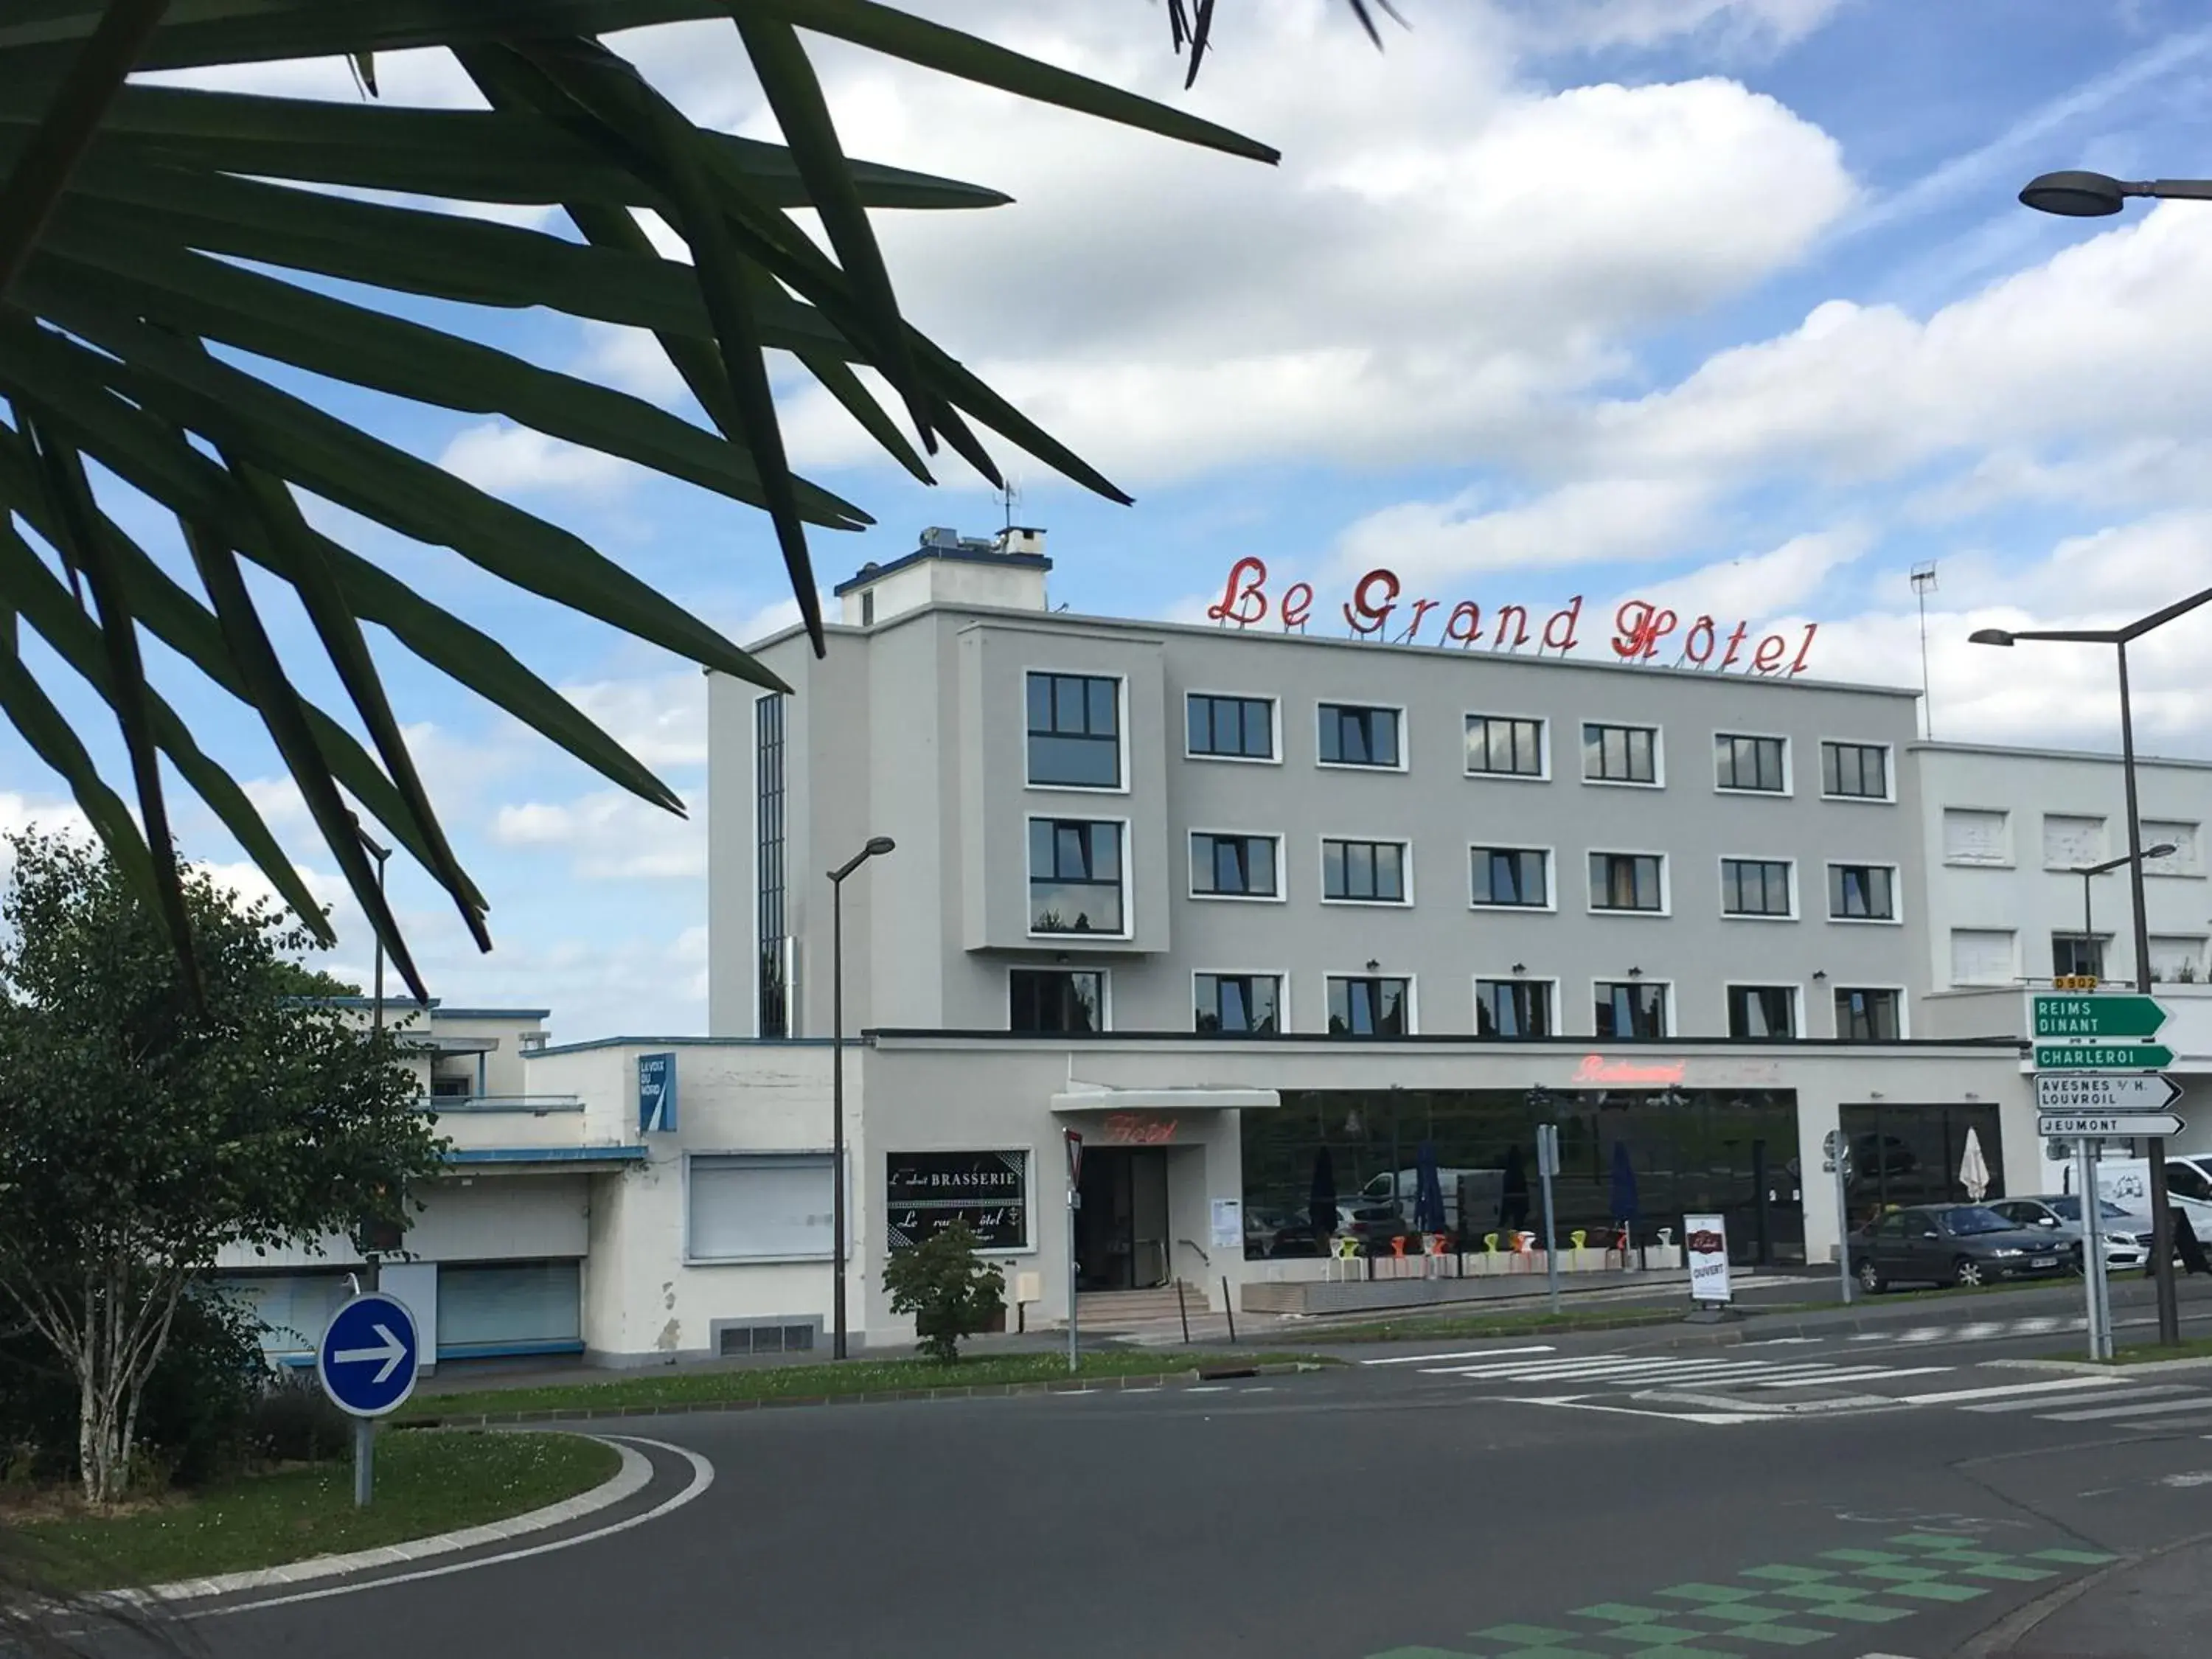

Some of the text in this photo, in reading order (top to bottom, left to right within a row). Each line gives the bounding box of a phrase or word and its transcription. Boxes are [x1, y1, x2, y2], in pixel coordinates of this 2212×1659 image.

[1207, 556, 1818, 672] Le Grand Hôtel
[2039, 1002, 2092, 1015] REIMS
[2039, 1018, 2099, 1032] DINANT
[2040, 1050, 2135, 1064] CHARLEROI
[2042, 1080, 2110, 1092] AVESNES
[2042, 1093, 2116, 1105] LOUVROIL
[2045, 1120, 2118, 1131] JEUMONT
[931, 1172, 1015, 1186] BRASSERIE
